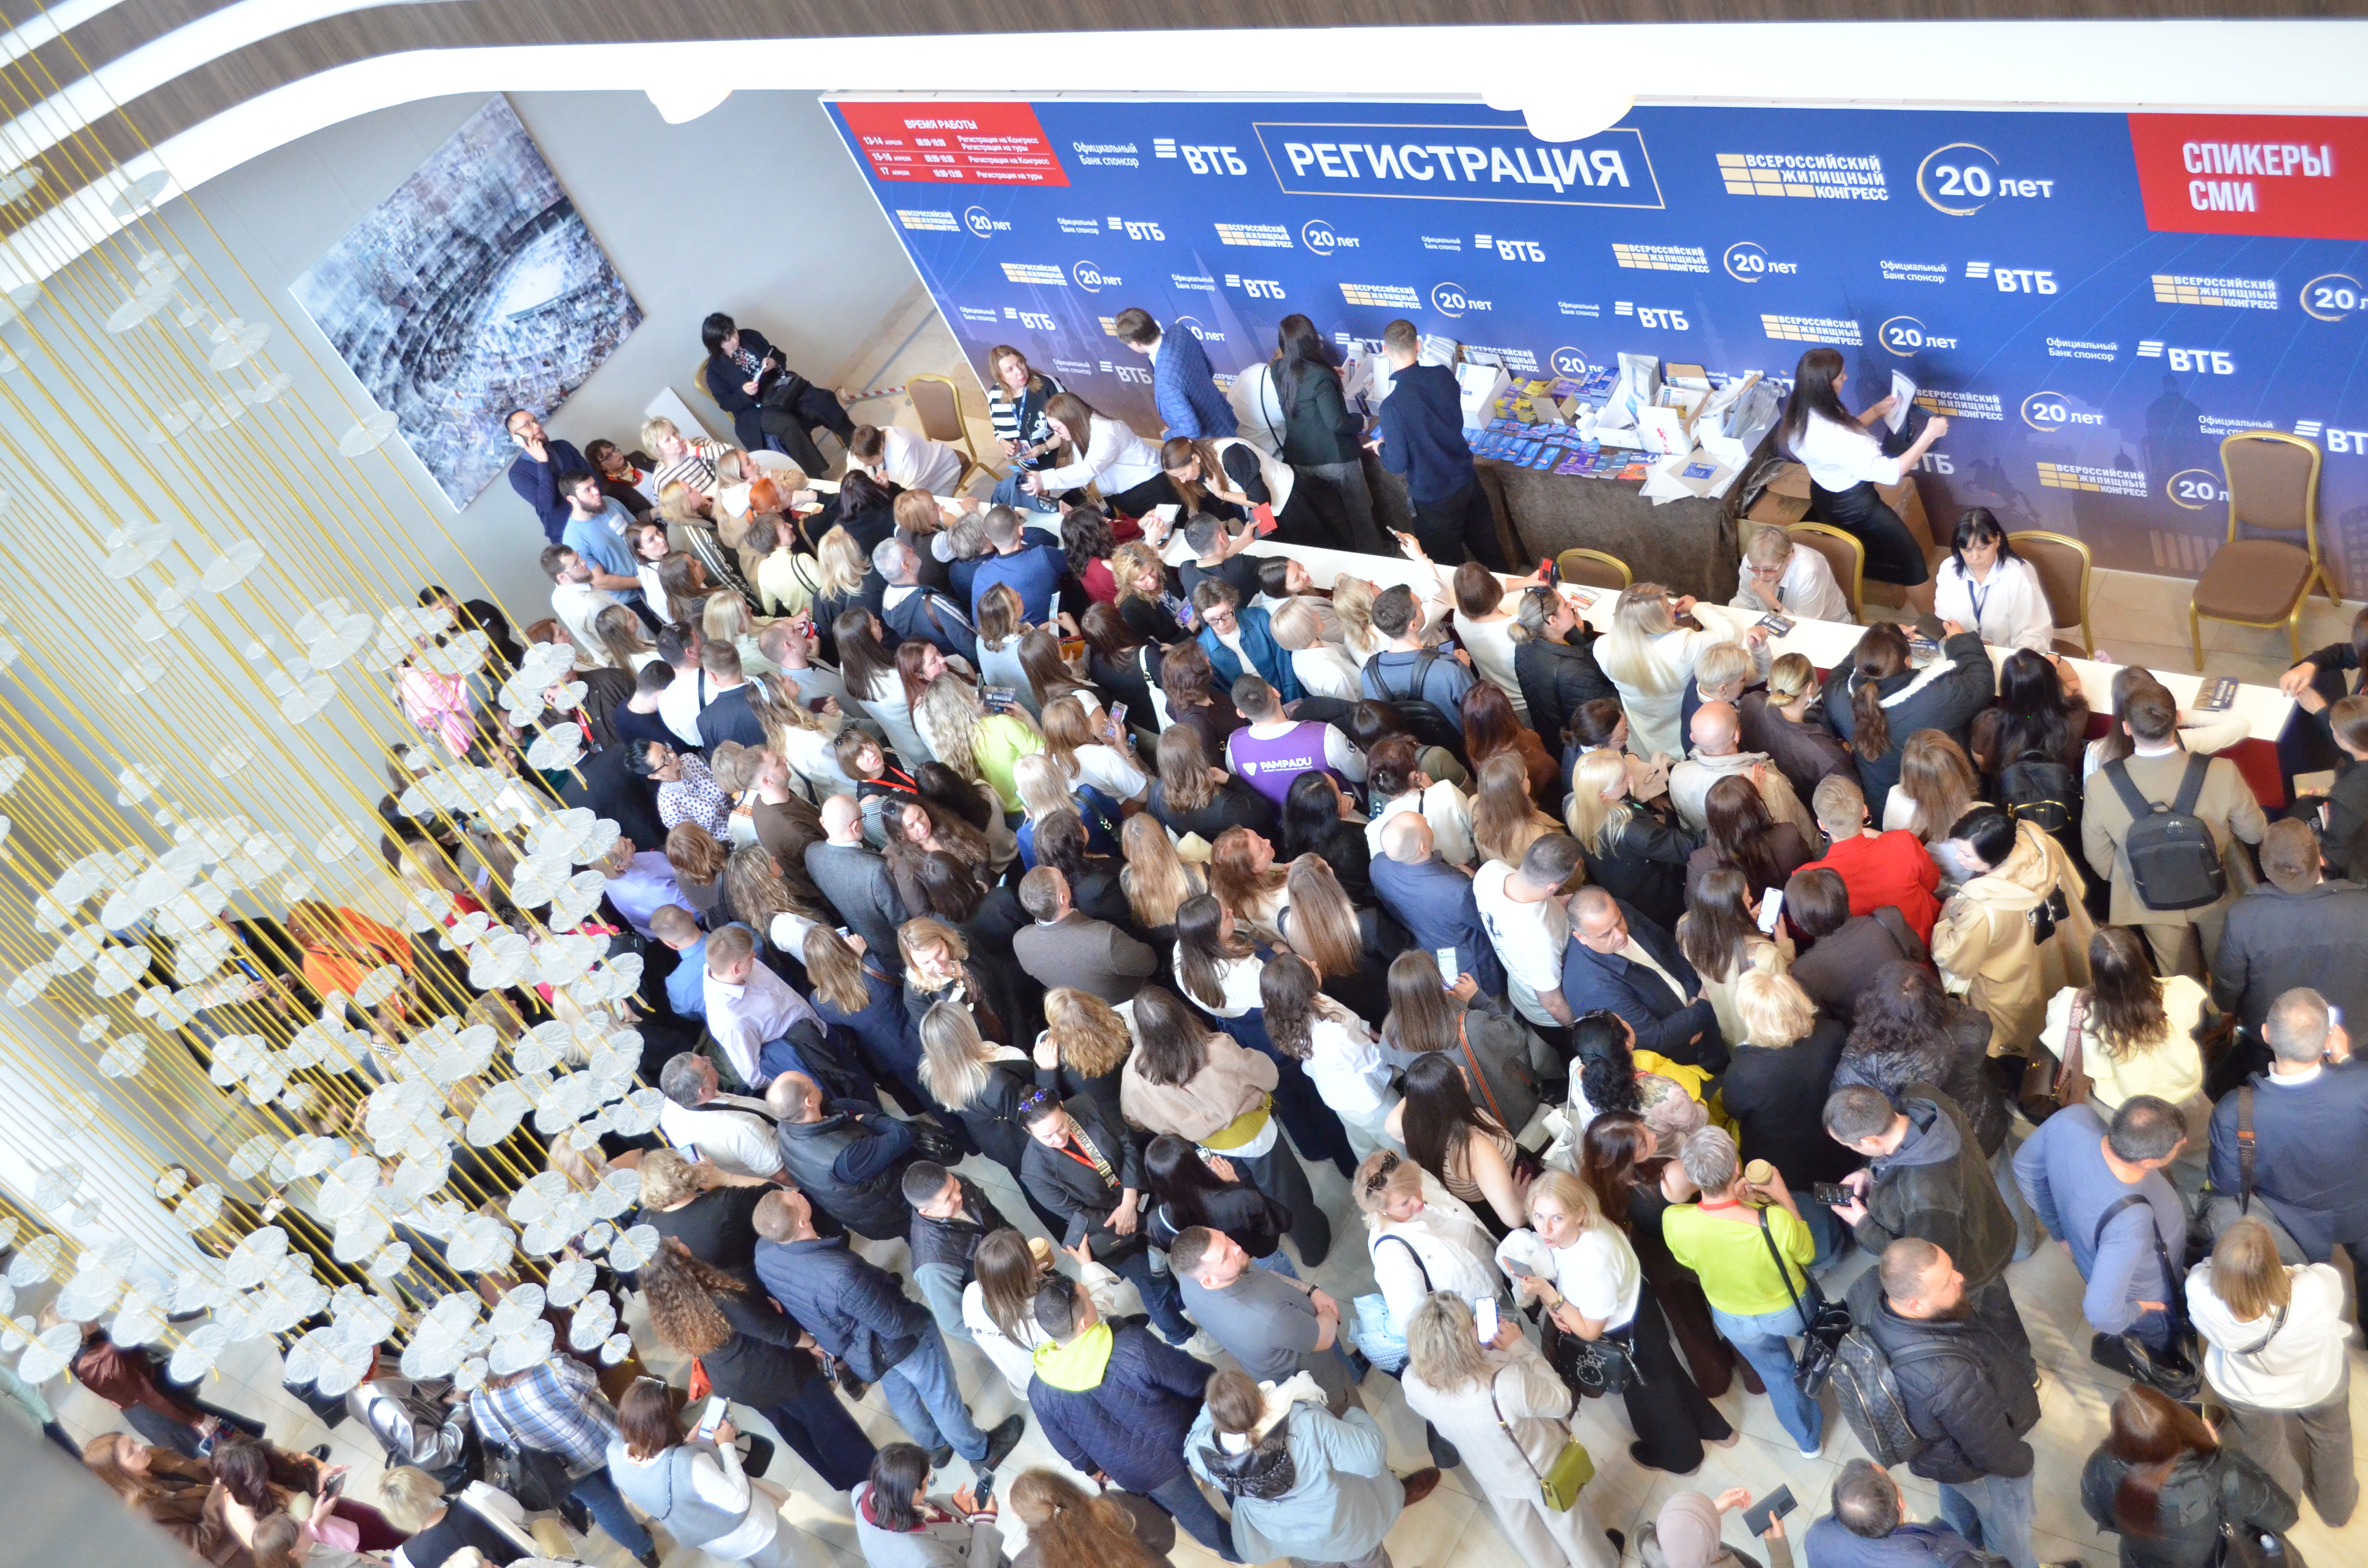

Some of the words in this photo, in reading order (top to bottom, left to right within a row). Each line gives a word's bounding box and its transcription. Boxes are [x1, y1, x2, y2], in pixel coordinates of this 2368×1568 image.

[904, 120, 938, 129] ВРЕМЯ
[938, 120, 978, 130] РАБОТЫ
[863, 136, 884, 145] 13-14
[957, 135, 999, 144] Регистрация
[962, 143, 1002, 151] Регистрация
[1073, 142, 1138, 154] Официальный
[872, 153, 893, 161] 15-16
[968, 156, 1010, 165] Регистрация
[1019, 157, 1050, 165] Конгресс
[1079, 155, 1101, 166] Банк
[1102, 157, 1139, 168] спонсор
[1180, 145, 1247, 175] ВТБ
[1745, 154, 1881, 171] ВСЕРОССИЙСКИЙ
[2182, 143, 2331, 177] СПИКЕРЫ
[880, 167, 889, 175] 17
[976, 171, 1017, 180] Регистрация
[1284, 142, 1630, 193] РЕГИСТРАЦИЯ
[1780, 168, 1885, 186] ЖИЛИЩНЫЙ
[1935, 165, 1991, 197] 20
[1999, 178, 2054, 198] лет
[1815, 184, 1888, 201] КОНГРЕСС
[2188, 180, 2256, 212] СМИ
[971, 215, 992, 230] 20
[992, 221, 1012, 231] лет
[1227, 223, 1287, 233] ВСЕРОССИЙСКИЙ
[1124, 221, 1166, 241] ВТБ
[1245, 231, 1291, 241] ЖИЛИЩНЫЙ
[1262, 239, 1294, 248] КОНГРЕСС
[1309, 230, 1335, 247] 20
[1336, 236, 1360, 248] лет
[1495, 240, 1546, 262] ВТБ
[1629, 244, 1705, 257] ВСЕРОССИЙСКИЙ
[1649, 253, 1707, 265] ЖИЛИЩНЫЙ
[1733, 253, 1764, 273] 20
[1768, 261, 1798, 274] лет
[1880, 259, 1948, 273] Официальный
[1669, 263, 1710, 274] КОНГРЕСС
[1079, 270, 1102, 285] 20
[1102, 276, 1122, 286] лет
[1172, 273, 1215, 284] Официальный
[1883, 270, 1906, 281] Банк
[1907, 272, 1945, 284] спонсор
[1994, 268, 2058, 294] ВТБ
[2174, 276, 2275, 290] ВСЕРОССИЙСКИЙ
[1190, 284, 1215, 292] спонсор
[1243, 279, 1286, 299] ВТБ
[1353, 284, 1416, 295] ВСЕРОССИЙСКИЙ
[2198, 286, 2277, 300] ЖИЛИЩНЫЙ
[1370, 292, 1419, 303] ЖИЛИЩНЫЙ
[1388, 300, 1422, 309] КОНГРЕСС
[1439, 292, 1466, 309] 20
[1468, 299, 1492, 311] лет
[2223, 298, 2278, 310] КОНГРЕСС
[2314, 288, 2354, 309] 20
[1558, 300, 1600, 311] Официальный
[1561, 308, 1576, 316] Банк
[1576, 309, 1600, 318] спонсор
[1637, 306, 1689, 331] ВТБ
[1019, 312, 1056, 330] ВТБ
[1778, 315, 1859, 330] ВСЕРОССИЙСКИЙ
[1205, 331, 1225, 342] лет
[1799, 325, 1861, 338] ЖИЛИЩНЫЙ
[1889, 327, 1922, 347] 20
[1926, 336, 1957, 349] лет
[1820, 335, 1863, 346] КОНГРЕСС
[2046, 337, 2117, 351] Официальный
[2048, 348, 2072, 358] Банк
[2073, 350, 2114, 362] спонсор
[2167, 347, 2234, 375] ВТБ
[1558, 356, 1586, 374] 20
[1114, 366, 1153, 384] ВТБ
[1916, 389, 2000, 404] ВСЕРОССИЙСКИЙ
[1936, 399, 2002, 413] ЖИЛИЩНЫЙ
[1958, 409, 2004, 421] КОНГРЕСС
[2032, 403, 2066, 423] 20
[2070, 412, 2103, 425] лет
[2198, 415, 2273, 429] Официальный
[2200, 425, 2225, 435] Банк
[2326, 429, 2368, 455] ВТ
[1910, 453, 1954, 475] ТБ
[2056, 464, 2145, 480] ВСЕРОССИЙСКИЙ
[2078, 474, 2146, 489] ЖИЛИЩНЫЙ
[2099, 485, 2147, 498] КОНГРЕСС
[2178, 480, 2213, 500] 20
[1260, 757, 1312, 770] PAMPADU
